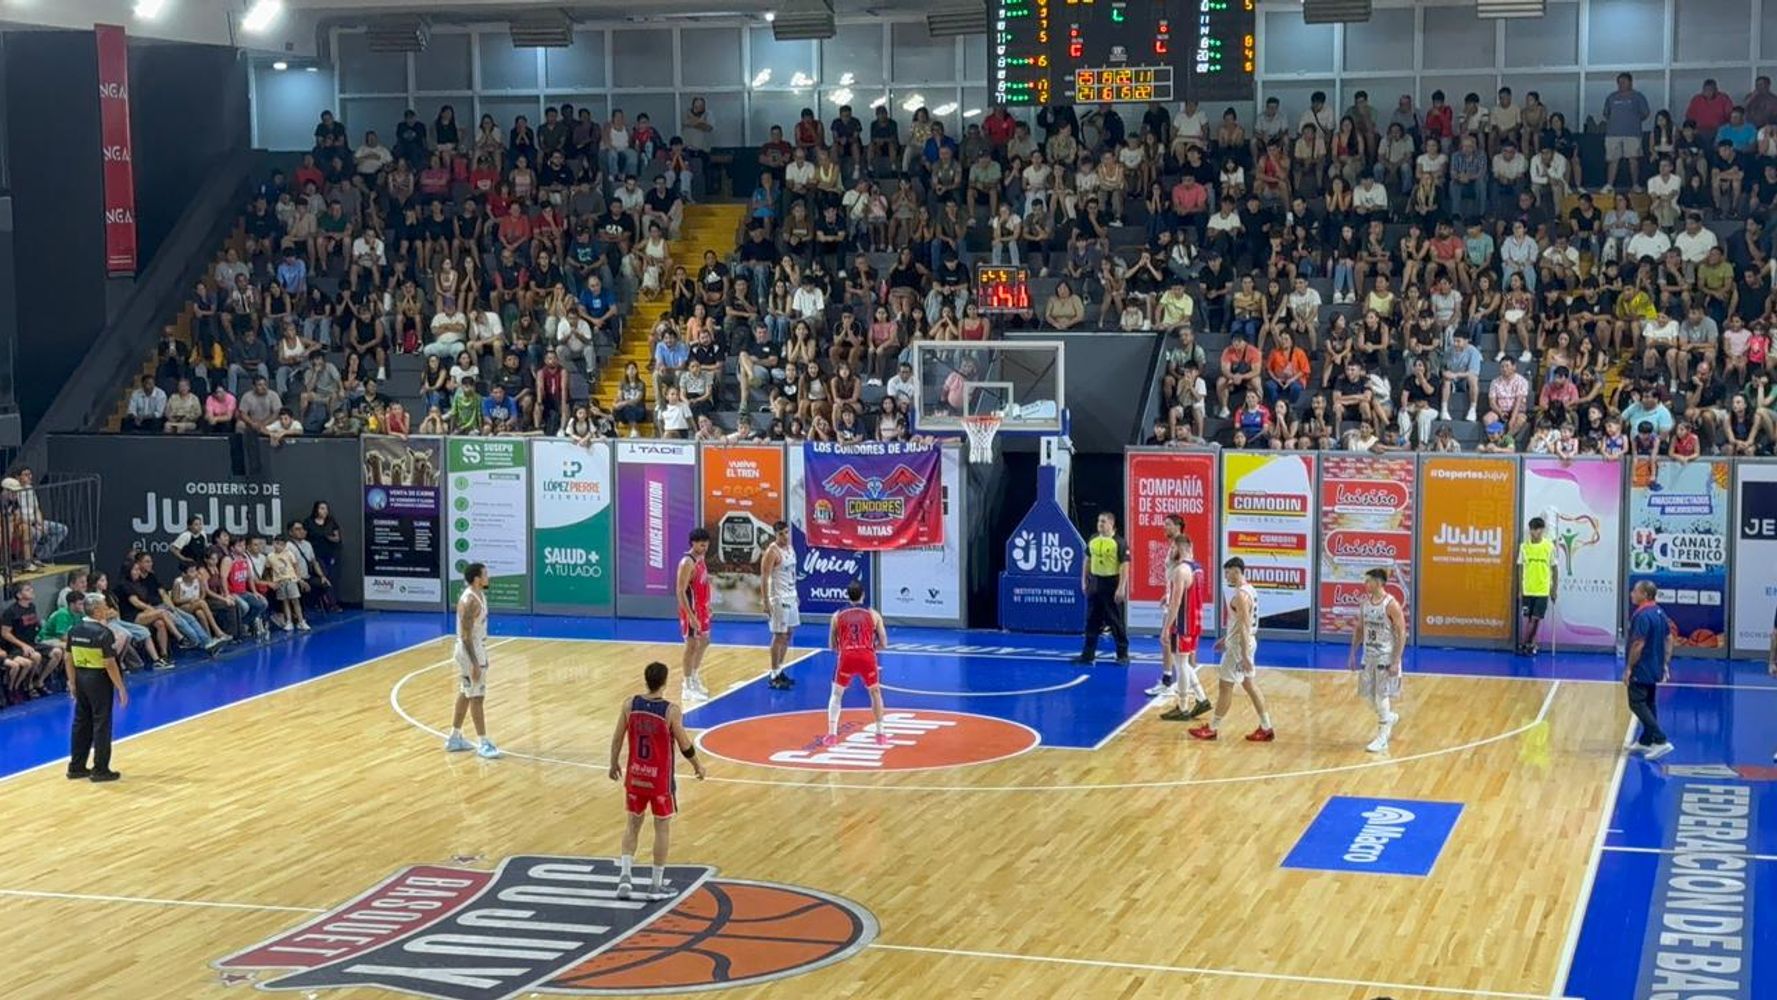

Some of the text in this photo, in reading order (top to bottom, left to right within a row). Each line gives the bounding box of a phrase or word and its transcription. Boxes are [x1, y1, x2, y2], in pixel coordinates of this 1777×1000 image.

[813, 442, 832, 454] LOS
[887, 443, 901, 454] DE
[262, 483, 281, 496] DE
[570, 481, 601, 493] PIERRE
[1138, 475, 1204, 498] COMPAÑÍA
[849, 500, 903, 513] CONDORES
[1138, 497, 1204, 514] DE SEGUROS
[1233, 495, 1302, 512] COMODIN
[1138, 513, 1150, 526] DE
[1744, 519, 1777, 536] JE
[857, 525, 894, 536] MATIAS
[1041, 531, 1060, 546] IN
[1672, 536, 1722, 549] CANAL 2
[543, 547, 587, 564] SALUD
[1041, 545, 1075, 561] PRO
[1678, 549, 1723, 561] PERICO
[544, 565, 602, 578] A TU LADO
[1040, 558, 1073, 574] JUY
[1244, 566, 1301, 583] OMODIN
[636, 734, 651, 760] 6
[1343, 823, 1407, 864] Macro
[1665, 783, 1751, 912] FEDERACION
[268, 876, 473, 957] BASQUET
[1659, 912, 1743, 951] DE
